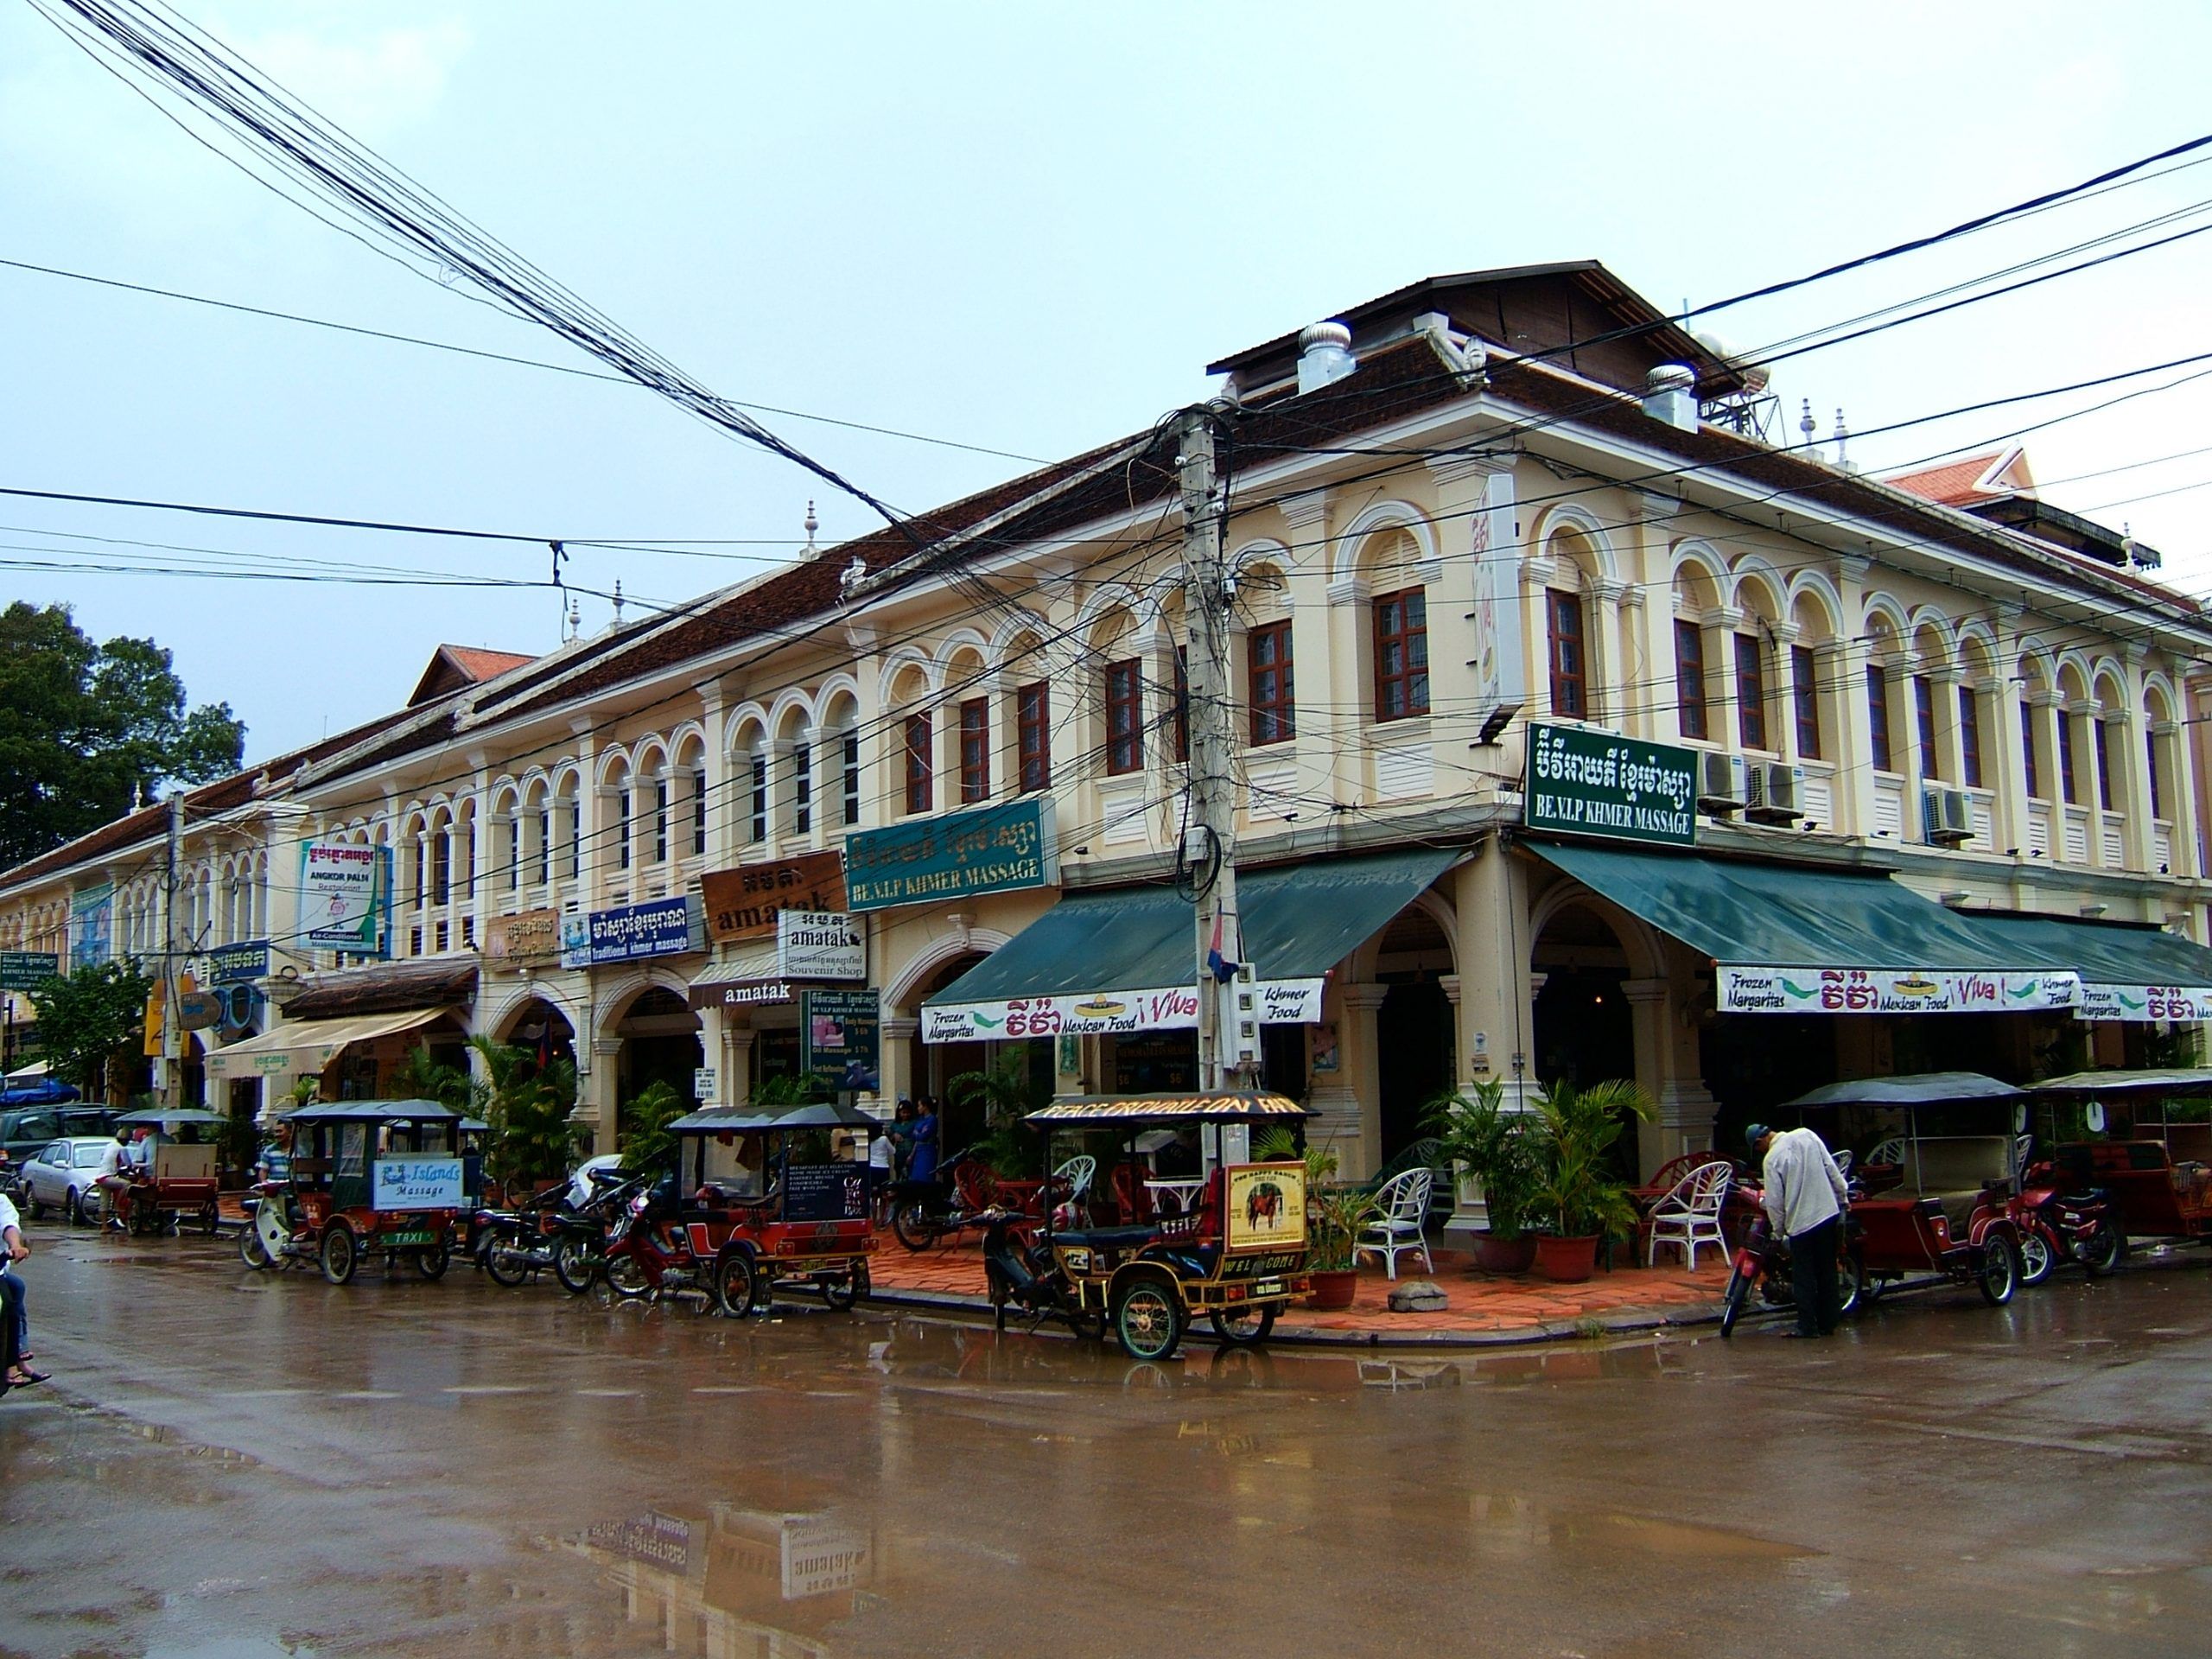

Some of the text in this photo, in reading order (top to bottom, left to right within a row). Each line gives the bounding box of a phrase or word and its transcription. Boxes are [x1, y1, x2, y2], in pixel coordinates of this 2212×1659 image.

[1535, 793, 1690, 835] BE.V.I.P KHMER MASSAGE
[310, 872, 369, 882] ANGKOR PALM
[906, 870, 961, 895] KHMER
[965, 859, 1039, 886] MASSAGE
[655, 936, 688, 951] massage
[791, 928, 850, 947] amatak
[788, 965, 862, 977] Souvenir Shop
[1731, 973, 1772, 989] Frozen
[2042, 977, 2074, 990] Khmer
[725, 981, 791, 1002] amatak
[1264, 987, 1310, 1001] Khmer
[2048, 992, 2072, 1005] Food
[2082, 988, 2111, 1001] Frozen
[1728, 990, 1784, 1011] Margaritas
[1879, 995, 1949, 1011] Mexican Food
[933, 1012, 965, 1024] Frozen
[1268, 1003, 1304, 1020] Food
[2081, 1004, 2121, 1019] Margaritas
[1062, 1015, 1137, 1035] Mexican Food
[929, 1025, 975, 1042] Margaritas
[823, 1046, 852, 1055] Massage
[1043, 1103, 1109, 1118] PEACE
[410, 1164, 461, 1182] Islands
[397, 1185, 444, 1198] Massage
[395, 1232, 423, 1243] TAXI
